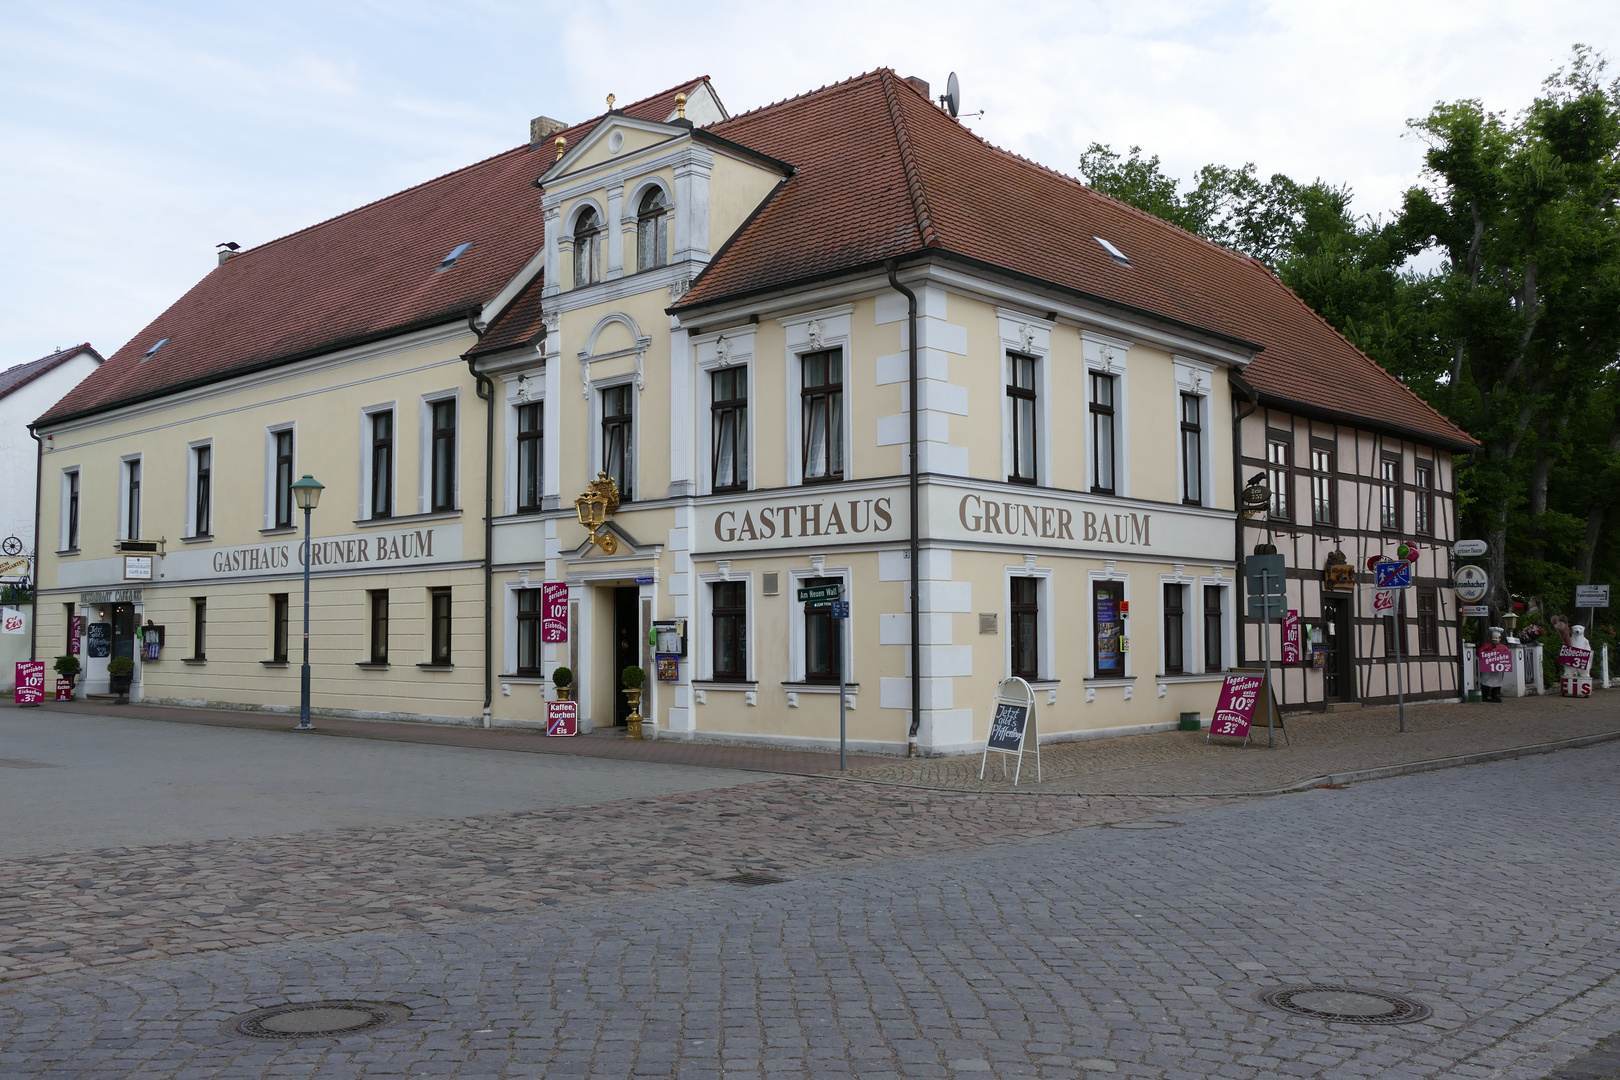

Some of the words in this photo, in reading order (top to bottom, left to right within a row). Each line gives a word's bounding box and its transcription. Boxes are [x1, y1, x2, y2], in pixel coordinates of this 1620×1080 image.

[714, 497, 893, 543] GASTHAUS
[958, 494, 1074, 540] GRÜNER
[1082, 510, 1151, 547] BAUM
[212, 545, 289, 573] GASTHAUS
[375, 529, 434, 561] BAUM
[1454, 580, 1486, 588] Krombacher
[809, 590, 825, 598] Neuen
[826, 587, 838, 596] Wall
[1373, 590, 1394, 612] Eis
[5, 616, 23, 632] Eis
[1560, 644, 1590, 657] Eisbecher
[1485, 654, 1509, 664] gerichte
[1226, 676, 1248, 685] Tages-
[1230, 681, 1259, 694] gerichte
[996, 706, 1020, 718] Jetzt
[1217, 714, 1248, 727] Eisbecher
